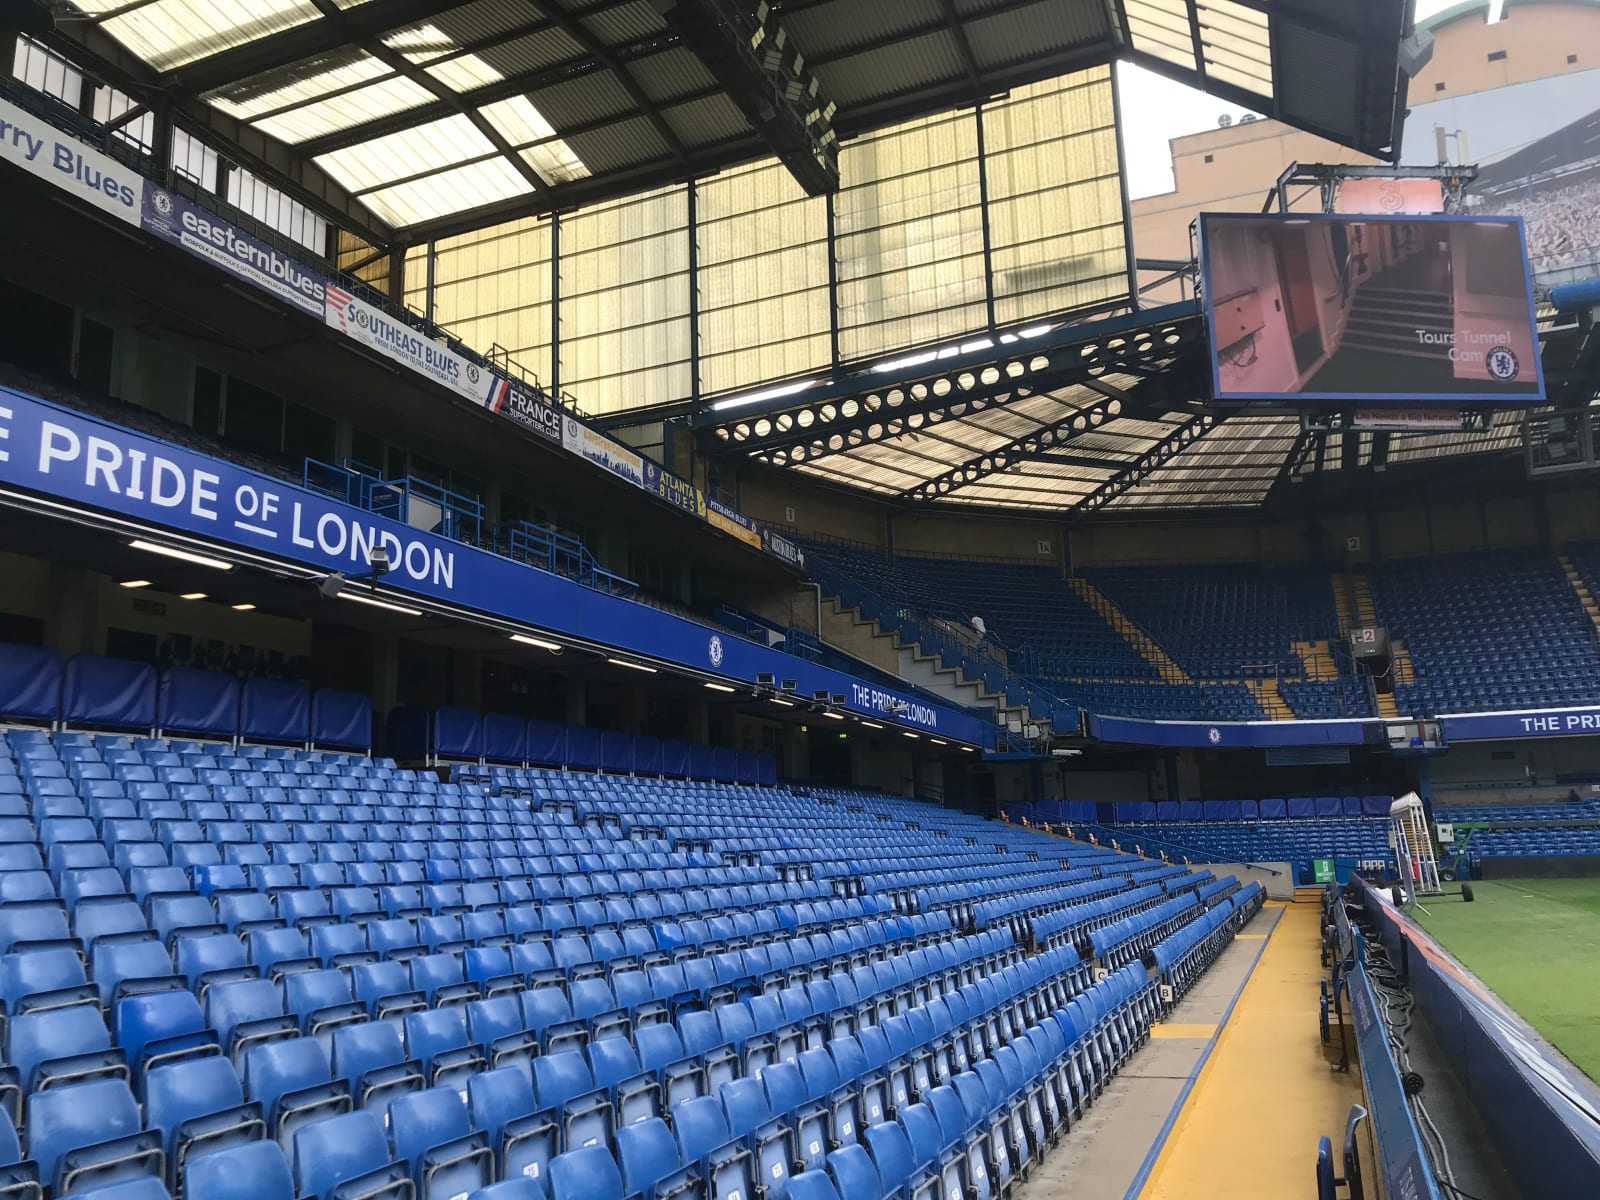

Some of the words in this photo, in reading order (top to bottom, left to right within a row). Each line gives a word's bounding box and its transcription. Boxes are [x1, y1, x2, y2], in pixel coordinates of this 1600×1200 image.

[53, 142, 135, 207] Blues
[181, 211, 325, 300] easternblues
[374, 336, 389, 351] FROM
[390, 345, 409, 361] LONDON
[1416, 330, 1456, 343] Tours
[1462, 329, 1511, 344] Tunnel
[425, 346, 460, 378] BLUES
[1448, 347, 1484, 361] Cam
[509, 389, 560, 431] FRANCE
[509, 407, 545, 433] SUPPORTERS
[545, 427, 560, 440] CLUB
[659, 484, 694, 512] BLUES
[660, 471, 694, 499] ATLANTA
[39, 420, 220, 521] PRIDE
[234, 484, 280, 522] OF
[292, 502, 454, 589] LONDON
[1364, 631, 1373, 640] 2
[852, 683, 870, 708] THE
[907, 702, 937, 727] LONDON
[1520, 716, 1561, 732] THE
[1162, 988, 1169, 997] B
